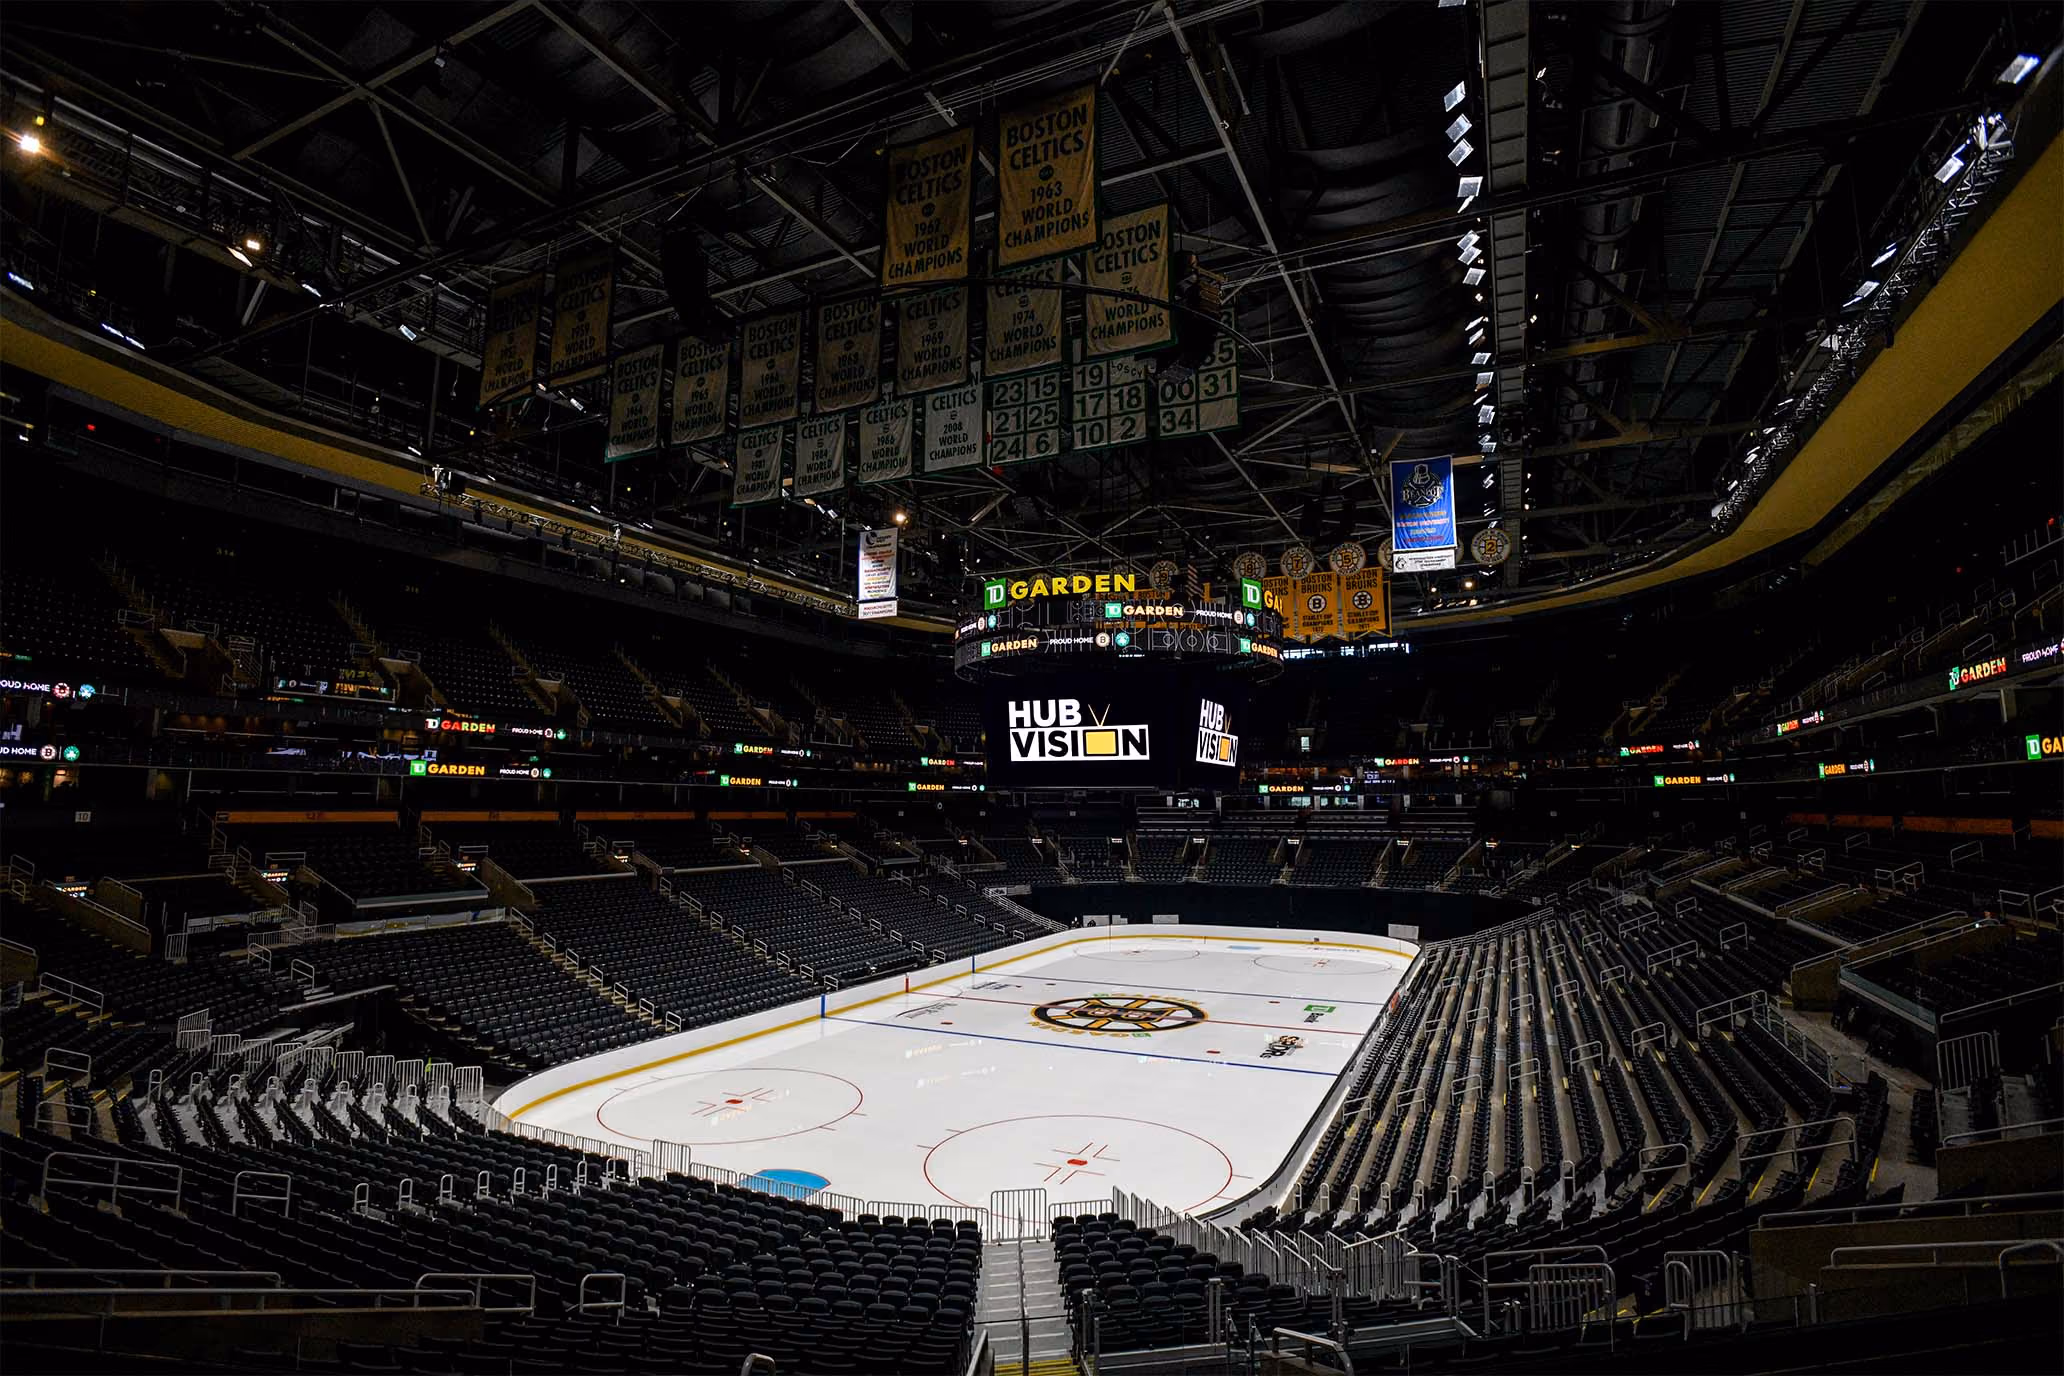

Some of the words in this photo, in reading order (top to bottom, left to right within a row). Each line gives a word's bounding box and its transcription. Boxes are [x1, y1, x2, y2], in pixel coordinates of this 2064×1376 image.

[1006, 107, 1087, 147] BOSTON
[1009, 130, 1084, 170] CELTICS
[896, 169, 962, 205] CELTICS
[1031, 181, 1063, 202] 1963
[1022, 198, 1073, 225] WORLD
[1004, 211, 1089, 248] CHAMPIONS
[904, 233, 949, 257] WORLD
[888, 249, 963, 280] CHAMPIONS
[1094, 243, 1159, 274] CELTICS
[824, 298, 878, 324] BOSTON
[906, 291, 960, 320] CELTICS
[1105, 302, 1149, 321] WORLD
[825, 313, 874, 341] CELTICS
[1012, 310, 1034, 325] 1974
[1091, 314, 1165, 340] CHAMPIONS
[749, 318, 797, 342] BOSTON
[1004, 324, 1044, 344] WORLD
[750, 333, 794, 360] CELTICS
[914, 345, 951, 363] WORLD
[991, 336, 1056, 361] CHAMPIONS
[618, 353, 659, 378] BOSTON
[681, 355, 723, 377] CELTICS
[902, 356, 962, 381] CHAMPIONS
[1078, 365, 1103, 388] 19
[618, 371, 657, 394] CELTICS
[819, 376, 876, 400] CHAMPIONS
[995, 382, 1023, 405] 23
[1030, 374, 1056, 398] 15
[1161, 379, 1193, 403] 00
[1204, 371, 1232, 396] 31
[932, 389, 977, 411] CELTICS
[1079, 393, 1104, 417] 17
[1115, 386, 1140, 410] 18
[685, 402, 713, 417] WORLD
[866, 404, 908, 425] CELTICS
[1029, 402, 1057, 427] 25
[674, 411, 722, 432] CHAMPIONS
[801, 419, 840, 439] CELTICS
[943, 422, 963, 434] 2008
[995, 410, 1021, 433] 21
[1121, 418, 1136, 440] 2
[1161, 409, 1193, 433] 34
[742, 431, 778, 450] CELTICS
[939, 433, 969, 446] WORLD
[1036, 432, 1050, 454] 6
[1077, 423, 1104, 446] 10
[872, 446, 900, 460] WORLD
[930, 443, 977, 461] CHAMPIONS
[994, 439, 1021, 461] 24
[806, 459, 833, 473] WORLD
[1486, 541, 1496, 552] 2
[1294, 559, 1300, 569] 7
[1344, 554, 1352, 564] 5
[986, 584, 1004, 604] TD
[1010, 573, 1135, 600] GARDEN
[1264, 578, 1289, 588] OSTON
[1301, 583, 1332, 594] BRUINS
[1345, 579, 1378, 591] BRUINS
[1123, 605, 1183, 617] GARDEN
[1195, 610, 1218, 618] PROUD
[1219, 611, 1233, 620] HOME
[992, 639, 1037, 652] GARDEN
[1251, 642, 1278, 657] GARDEN
[1960, 657, 2007, 683] GARDEN
[23, 682, 50, 692] HOME
[1008, 699, 1082, 728] HUB
[1199, 698, 1224, 731] HUB
[441, 720, 495, 732] GARDEN
[11, 747, 37, 756] HOME
[743, 745, 773, 754] GARDEN
[1630, 744, 1664, 754] GARDEN
[428, 763, 485, 775] GARDEN
[929, 758, 955, 766] GARDEN
[1385, 758, 1419, 766] GARDEN
[1825, 763, 1846, 775] GARDEN
[730, 776, 761, 786] GARDEN
[917, 783, 945, 791] GARDEN
[1269, 785, 1304, 793] GARDEN
[1665, 776, 1701, 785] GARDEN
